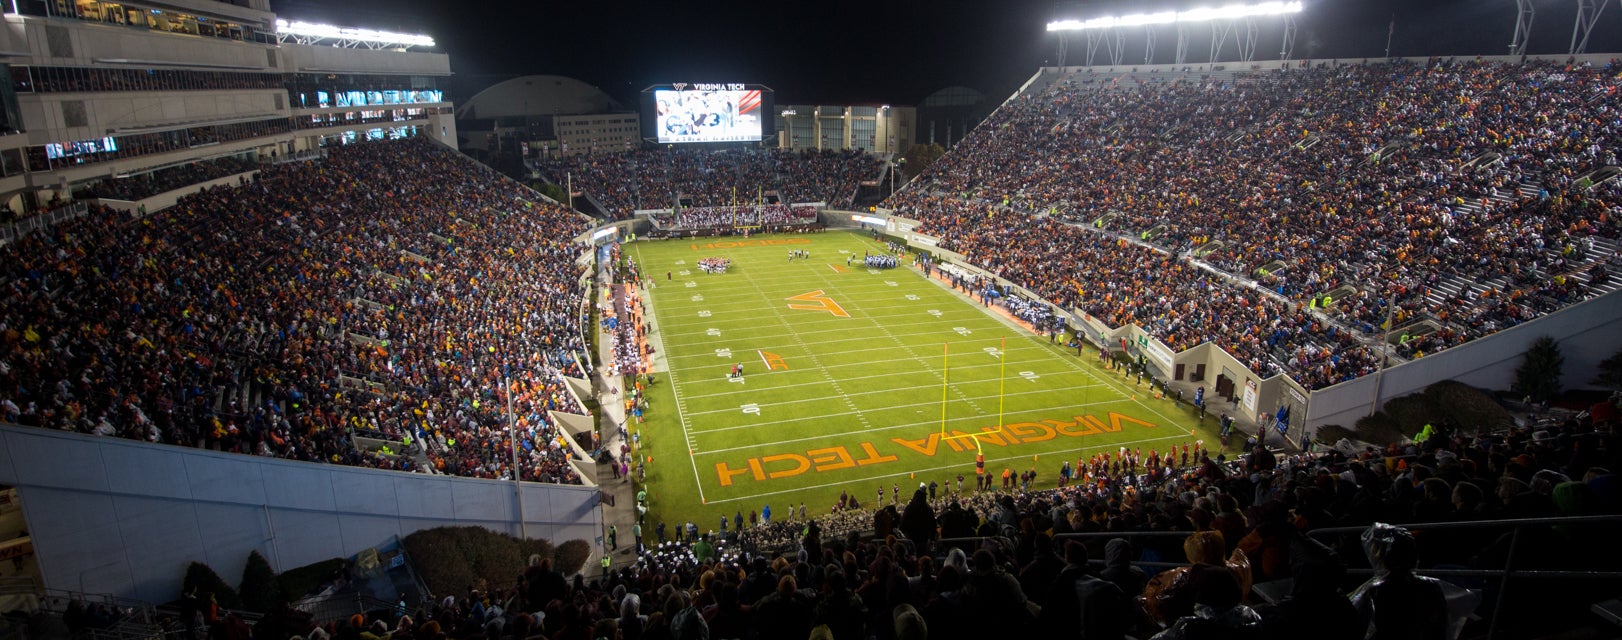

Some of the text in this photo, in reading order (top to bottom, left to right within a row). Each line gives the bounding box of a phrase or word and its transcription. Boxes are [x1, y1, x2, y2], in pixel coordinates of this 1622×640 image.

[693, 83, 745, 91] VIRGINIA TECH
[1018, 371, 1040, 380] 10
[740, 403, 760, 414] 10
[715, 411, 1158, 486] VIRGINIA TECH
